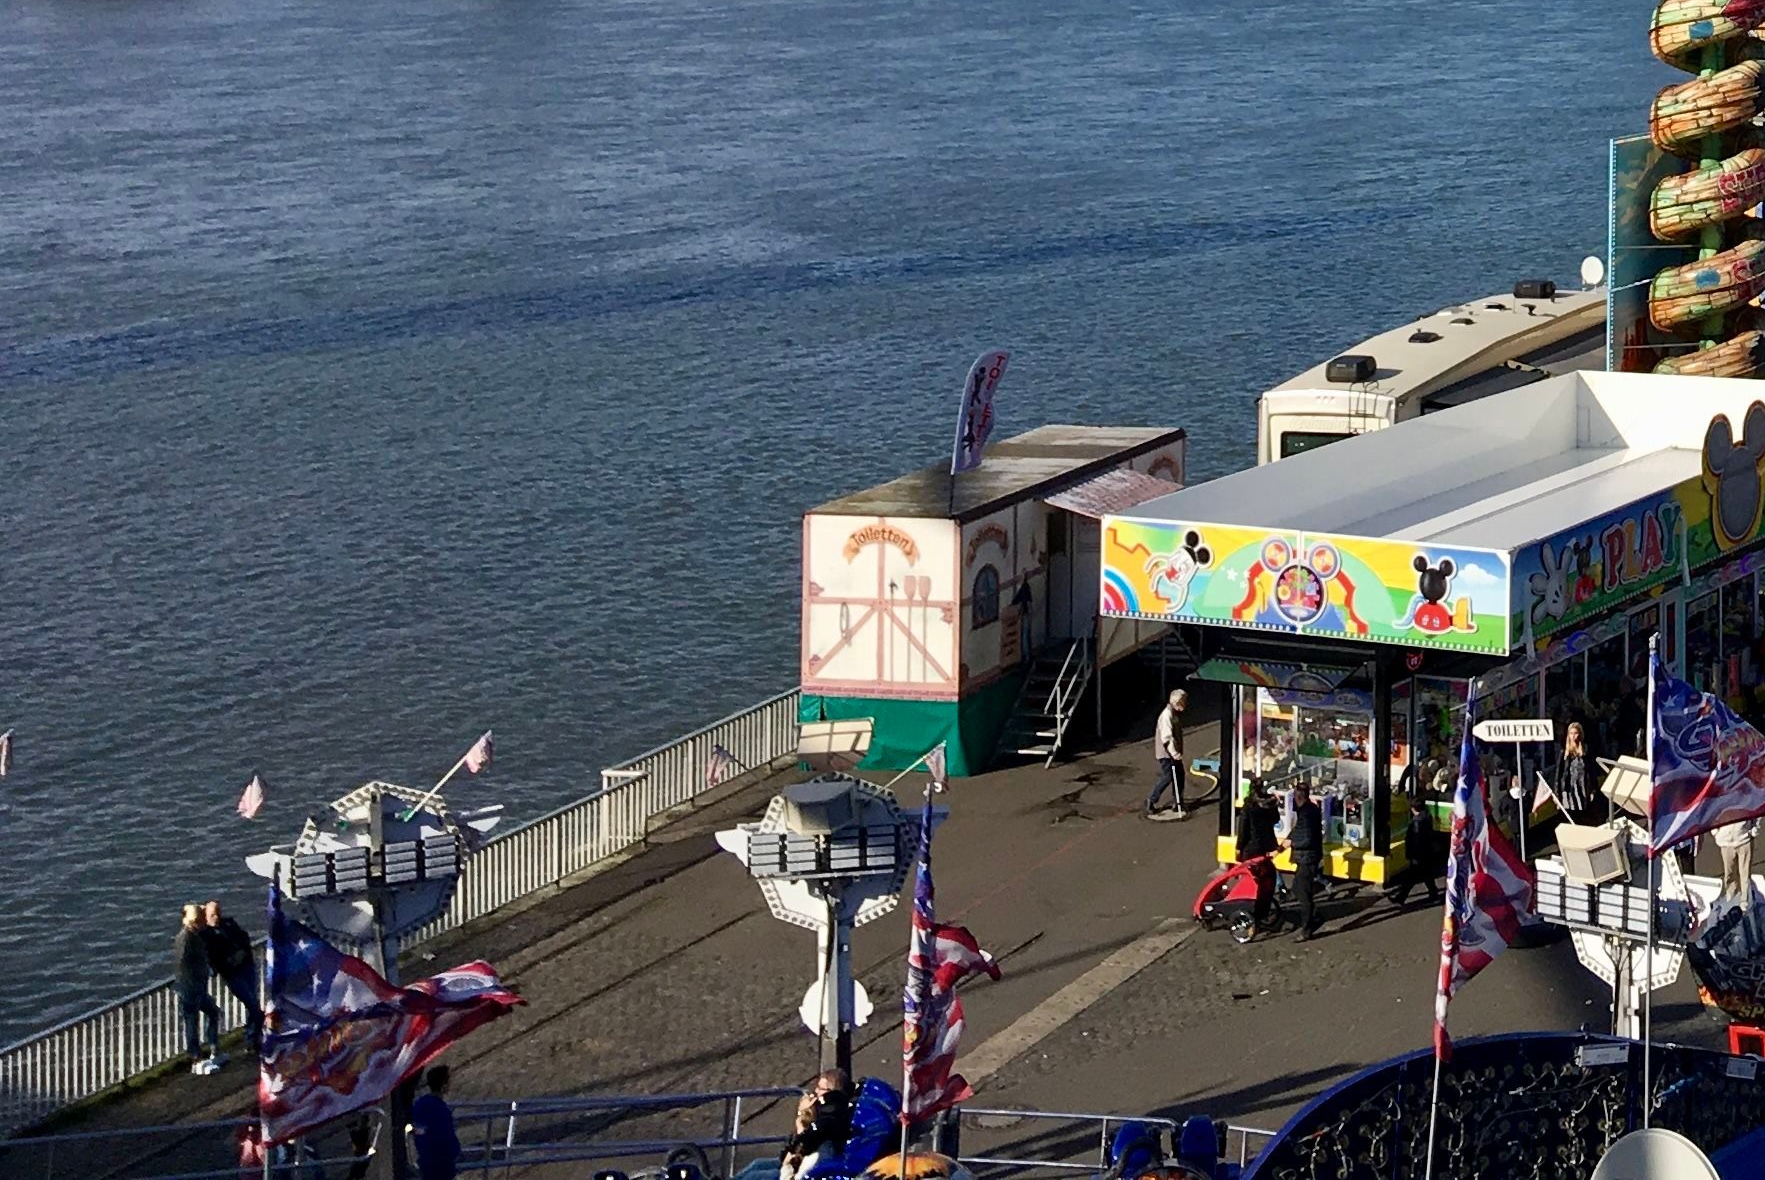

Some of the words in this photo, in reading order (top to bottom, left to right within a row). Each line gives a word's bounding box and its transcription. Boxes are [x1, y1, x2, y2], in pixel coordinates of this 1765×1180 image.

[849, 527, 909, 549] Toiletten
[1603, 501, 1682, 593] PLAY
[1485, 724, 1552, 737] TOILETTEN
